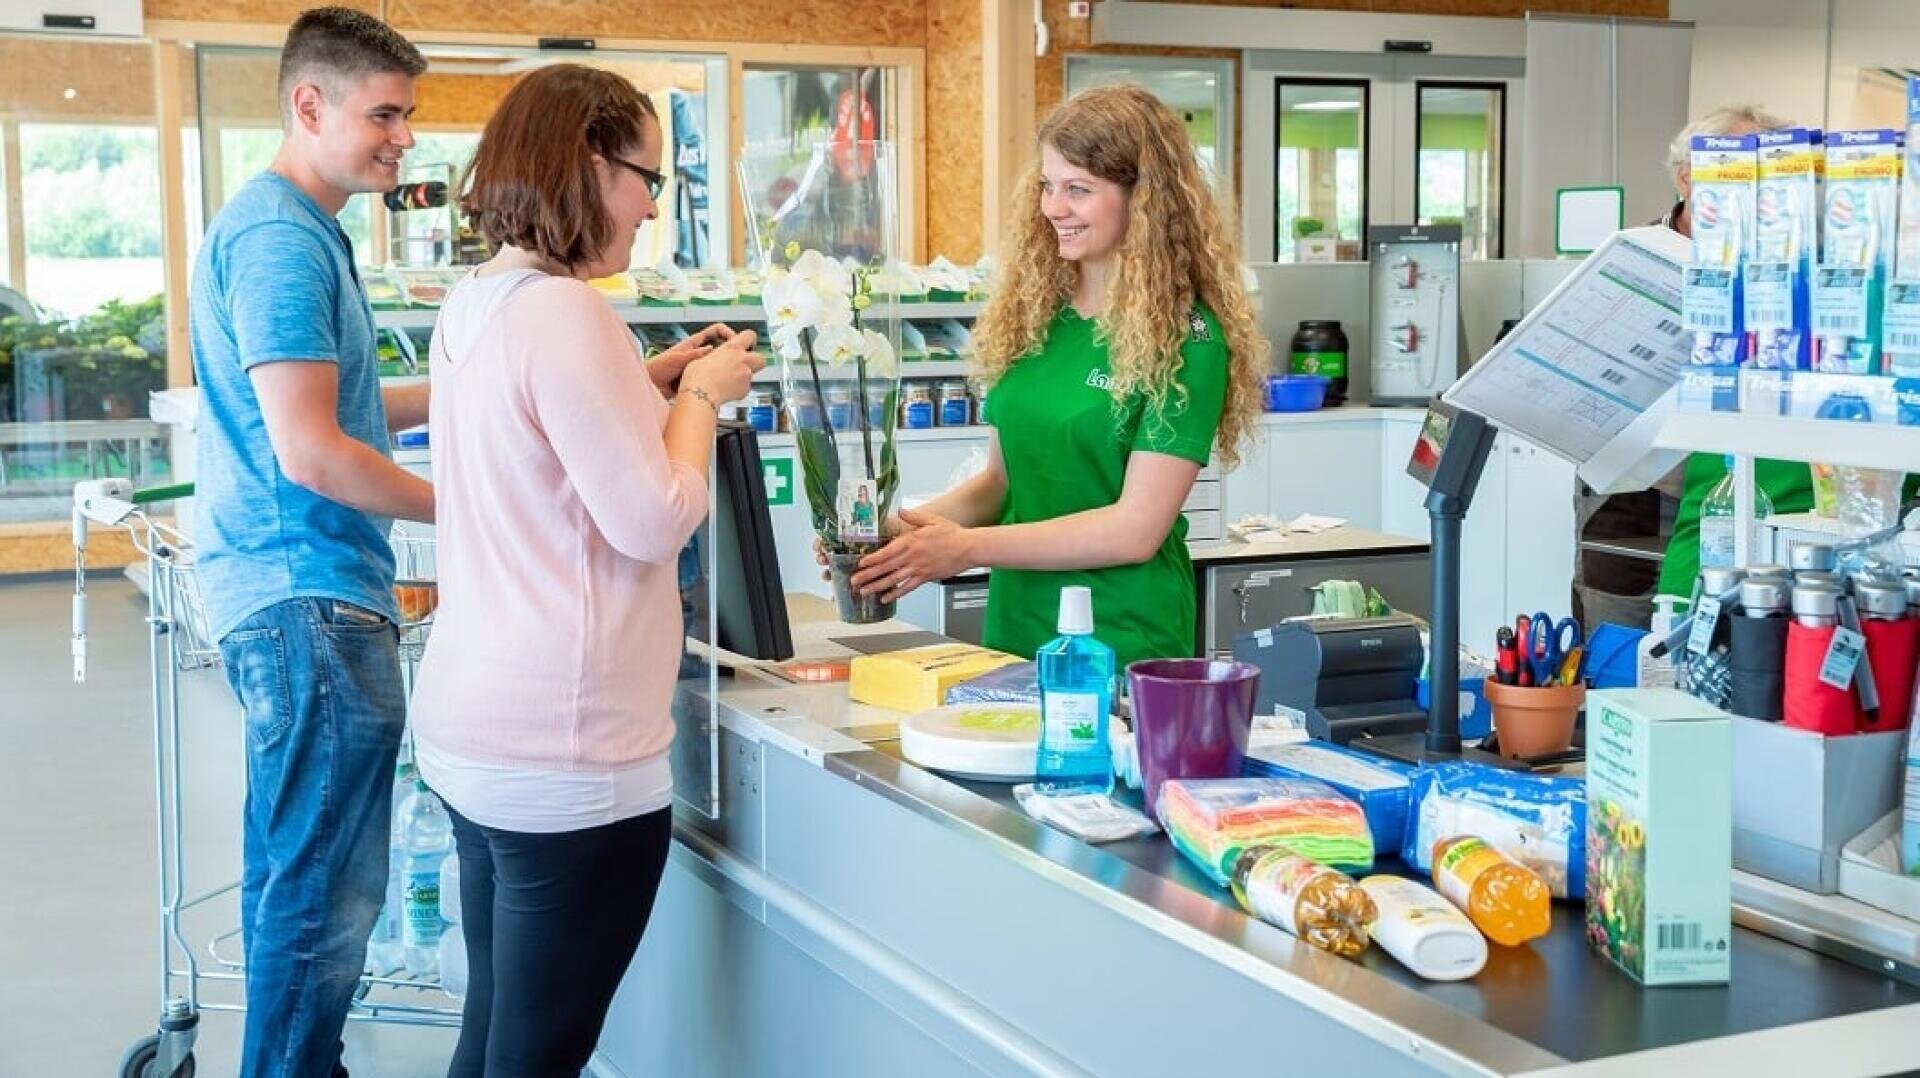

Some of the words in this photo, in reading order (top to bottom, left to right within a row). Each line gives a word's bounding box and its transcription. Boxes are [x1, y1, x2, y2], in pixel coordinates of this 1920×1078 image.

[1703, 136, 1743, 149] Trisa
[1717, 170, 1754, 180] PROMO
[1854, 165, 1893, 176] PROMO
